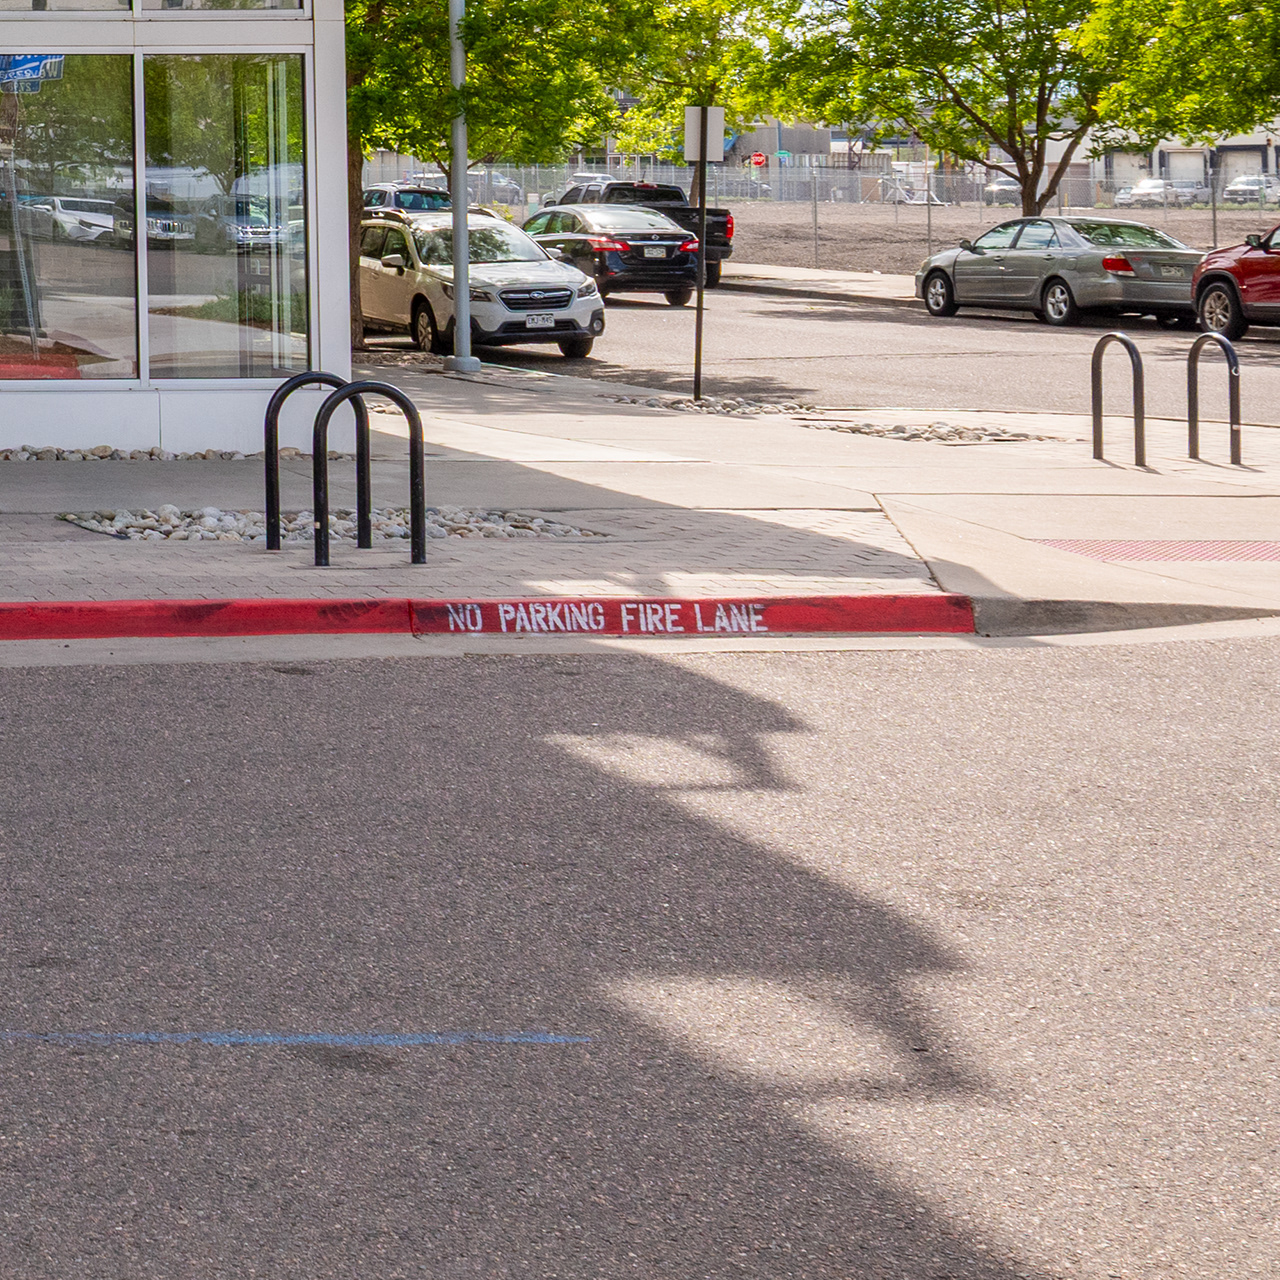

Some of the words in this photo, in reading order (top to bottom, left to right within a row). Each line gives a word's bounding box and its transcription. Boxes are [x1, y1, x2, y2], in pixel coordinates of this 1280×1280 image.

[446, 602, 482, 631] NO
[498, 602, 605, 633] PARKING
[620, 603, 685, 632] FIRE
[694, 603, 769, 632] LANE
